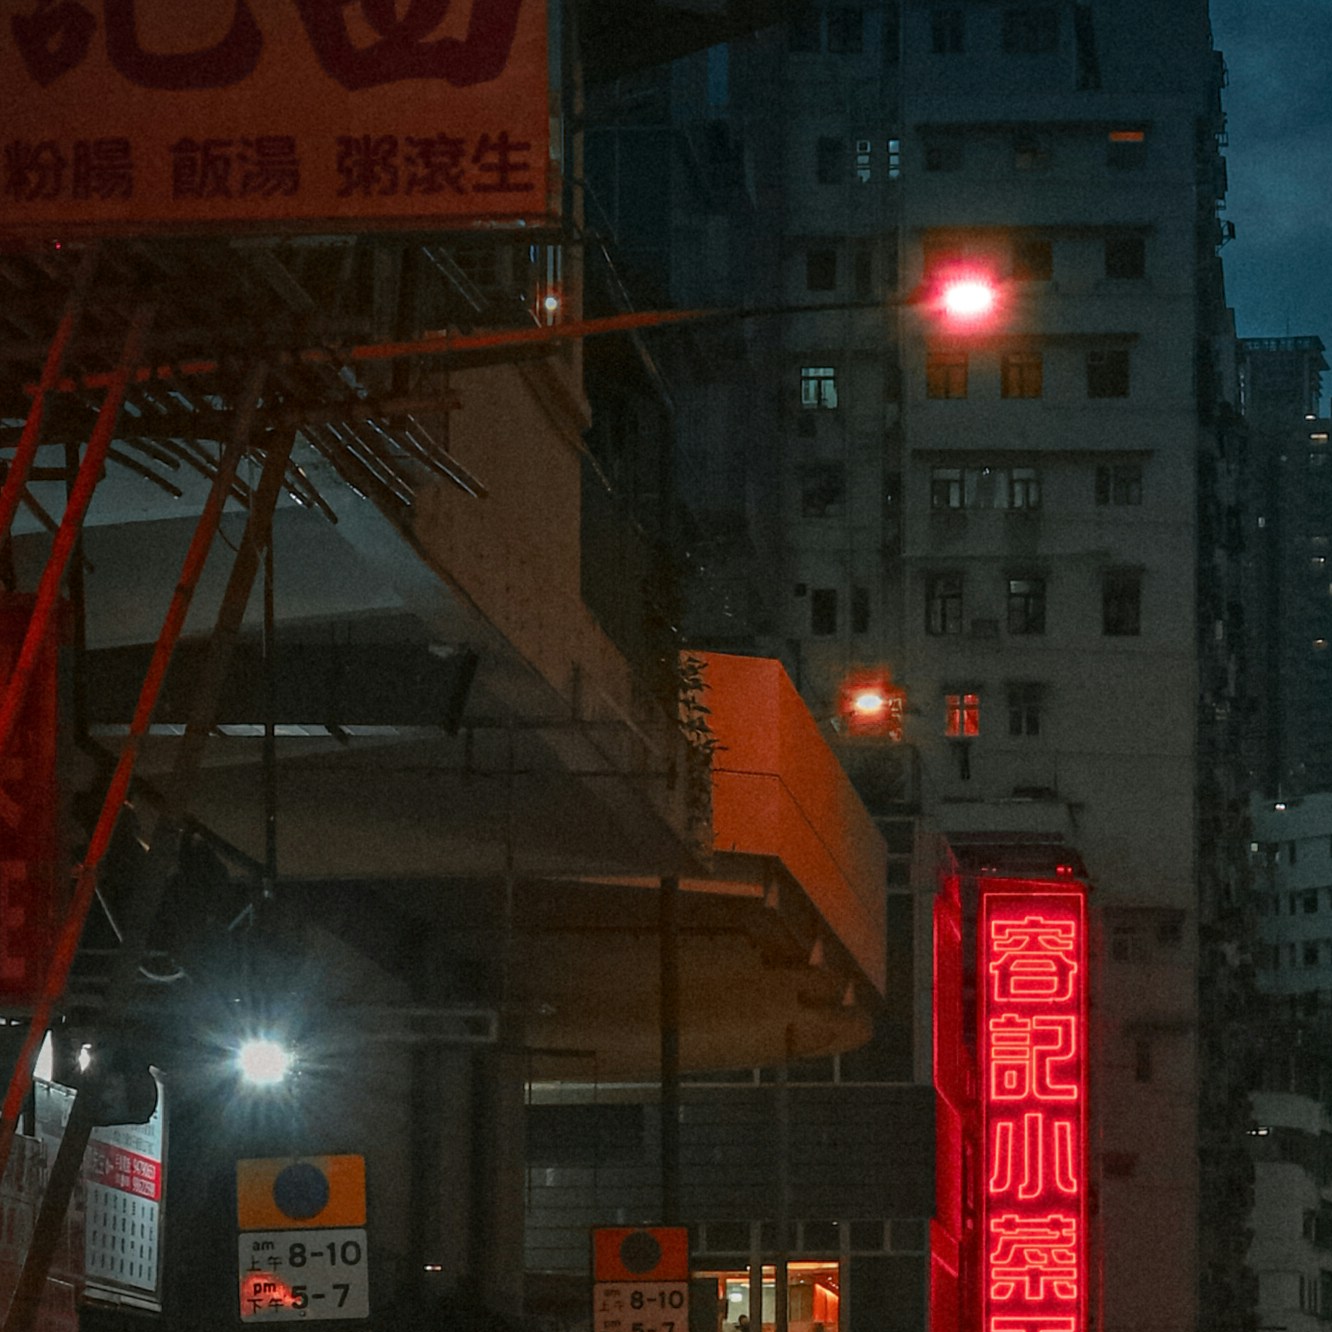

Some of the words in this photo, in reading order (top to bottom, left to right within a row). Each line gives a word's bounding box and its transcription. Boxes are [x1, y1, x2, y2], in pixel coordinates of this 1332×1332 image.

[251, 1241, 275, 1251] am
[289, 1241, 361, 1268] 8-10
[247, 1255, 282, 1271] 上午
[253, 1282, 276, 1298] pm
[247, 1298, 284, 1314] 下午
[631, 1290, 684, 1310] 8-10
